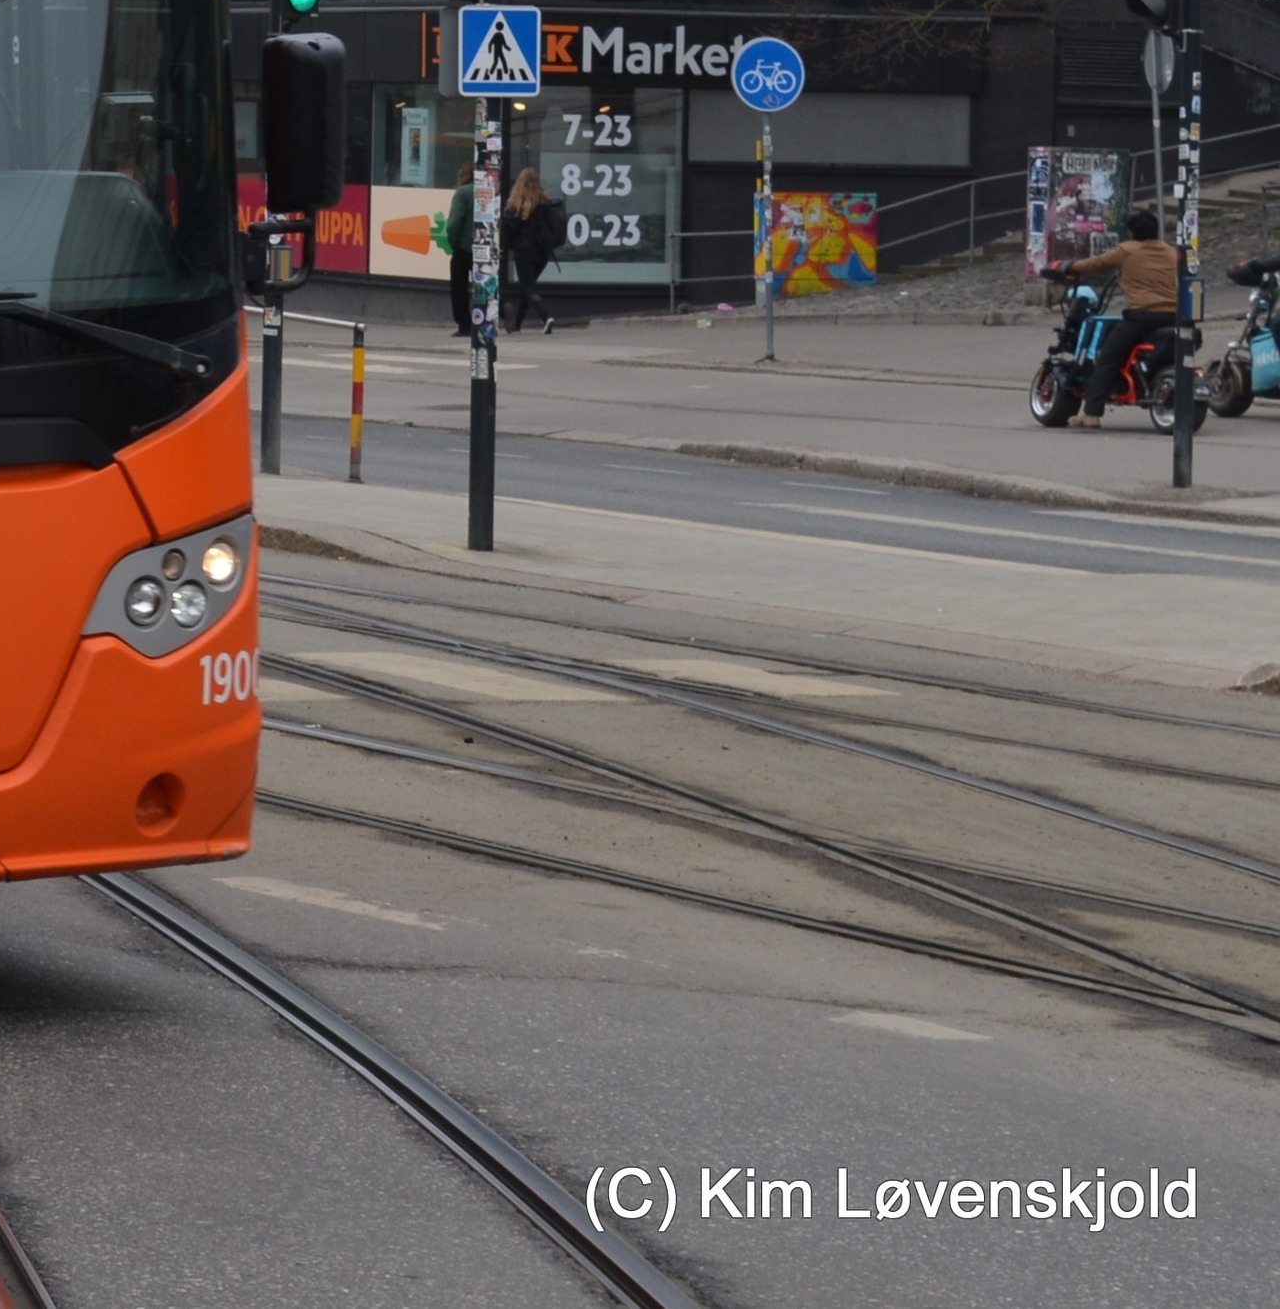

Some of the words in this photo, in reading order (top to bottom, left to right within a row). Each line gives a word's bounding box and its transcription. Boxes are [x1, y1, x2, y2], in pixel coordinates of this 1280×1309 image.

[562, 114, 632, 147] 7-23
[560, 164, 632, 197] 8-23
[567, 213, 641, 247] 0-23
